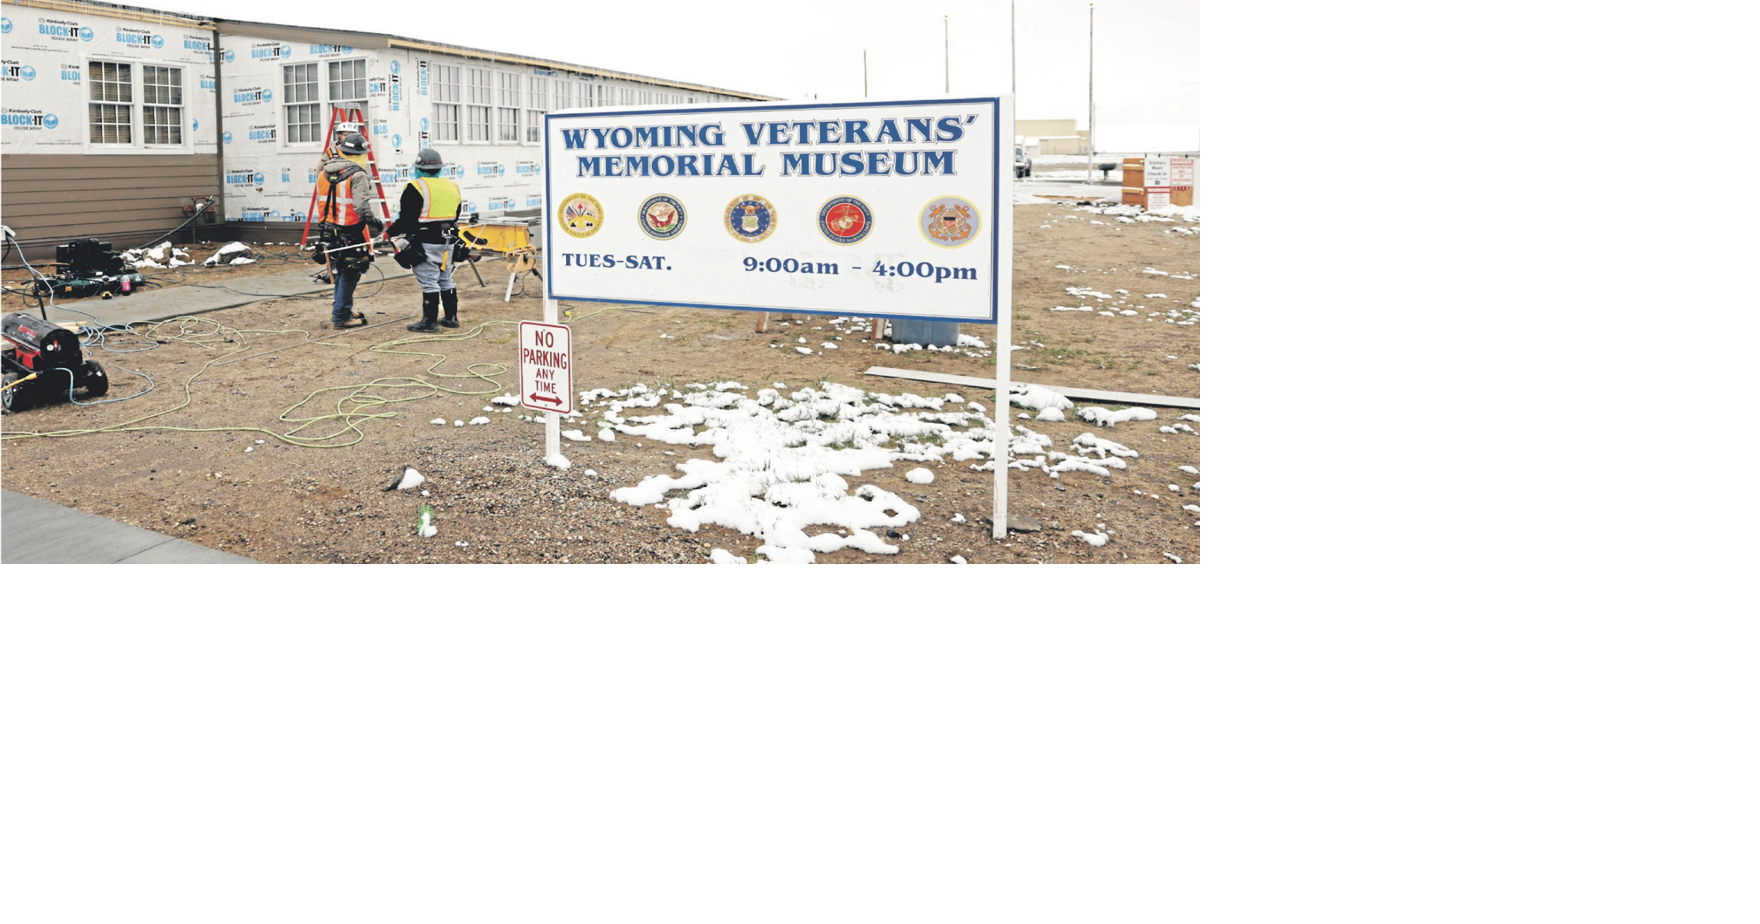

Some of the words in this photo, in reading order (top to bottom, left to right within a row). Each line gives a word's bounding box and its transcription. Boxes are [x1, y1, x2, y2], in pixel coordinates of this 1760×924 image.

[38, 24, 79, 38] BLOCK-IT
[116, 33, 151, 44] BLOCK-IT
[184, 40, 210, 50] BLOCK-I
[252, 47, 280, 58] BLOCK-IT
[234, 92, 261, 103] BLOCK-IT
[1, 114, 43, 125] BLOCK-IT
[560, 122, 726, 150] WYOMING
[576, 152, 766, 178] MEMORIAL
[780, 149, 958, 178] MUSEUM
[226, 174, 253, 184] BLOCK-IT
[562, 253, 672, 270] TUES-SAT.
[743, 256, 840, 275] 9:00am
[872, 260, 978, 283] 4:00pm
[535, 330, 554, 348] NO
[524, 348, 567, 370] PARKING
[536, 368, 554, 380] ANY
[535, 380, 556, 394] TIME
